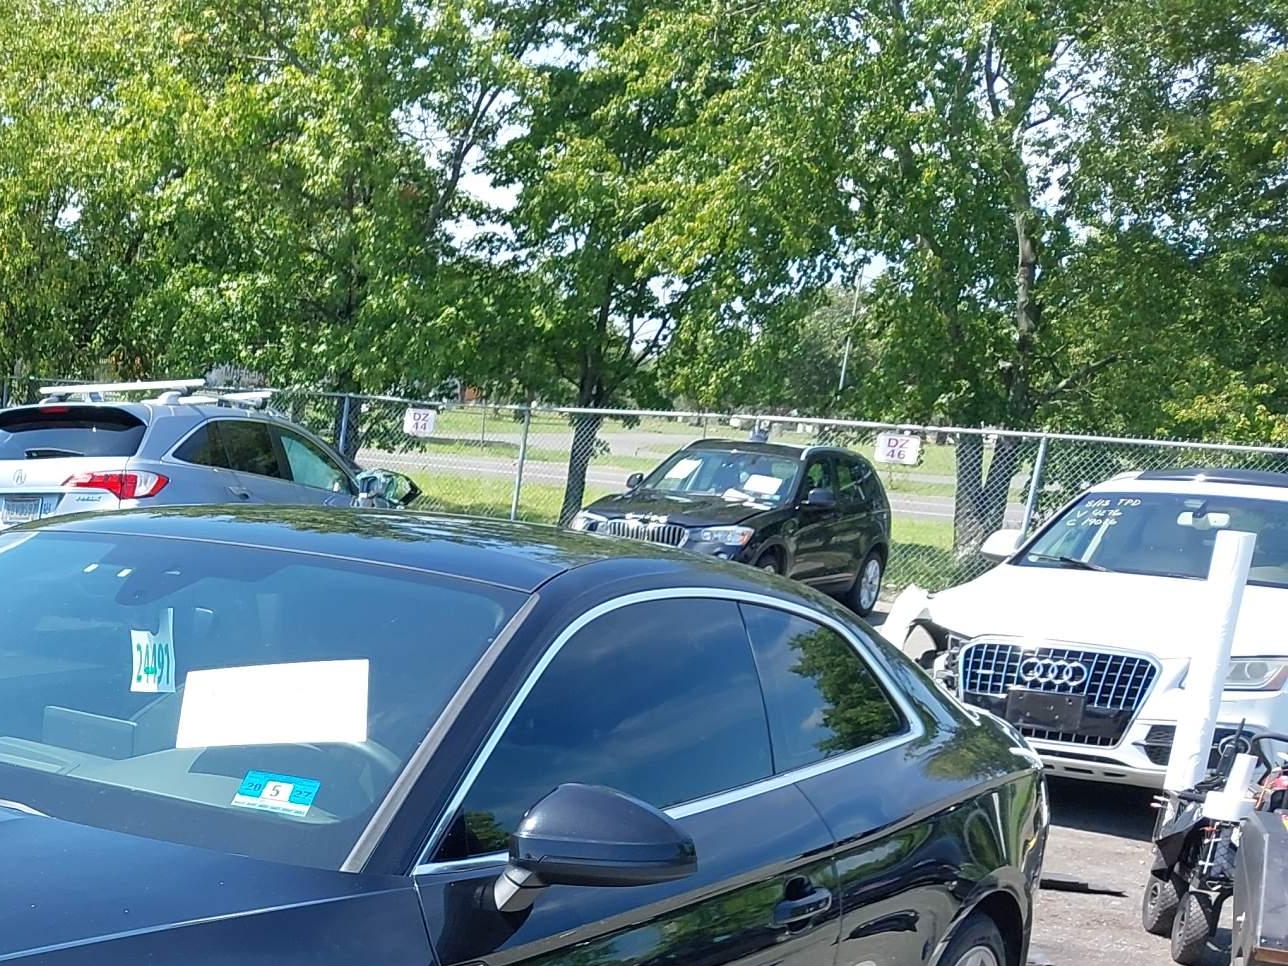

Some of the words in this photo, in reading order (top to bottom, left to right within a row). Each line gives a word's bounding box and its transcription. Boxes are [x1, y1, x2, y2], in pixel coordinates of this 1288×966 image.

[413, 412, 429, 422] DZ
[412, 422, 427, 431] 44
[887, 437, 910, 449] DZ
[886, 449, 906, 459] 46
[270, 784, 282, 797] 5
